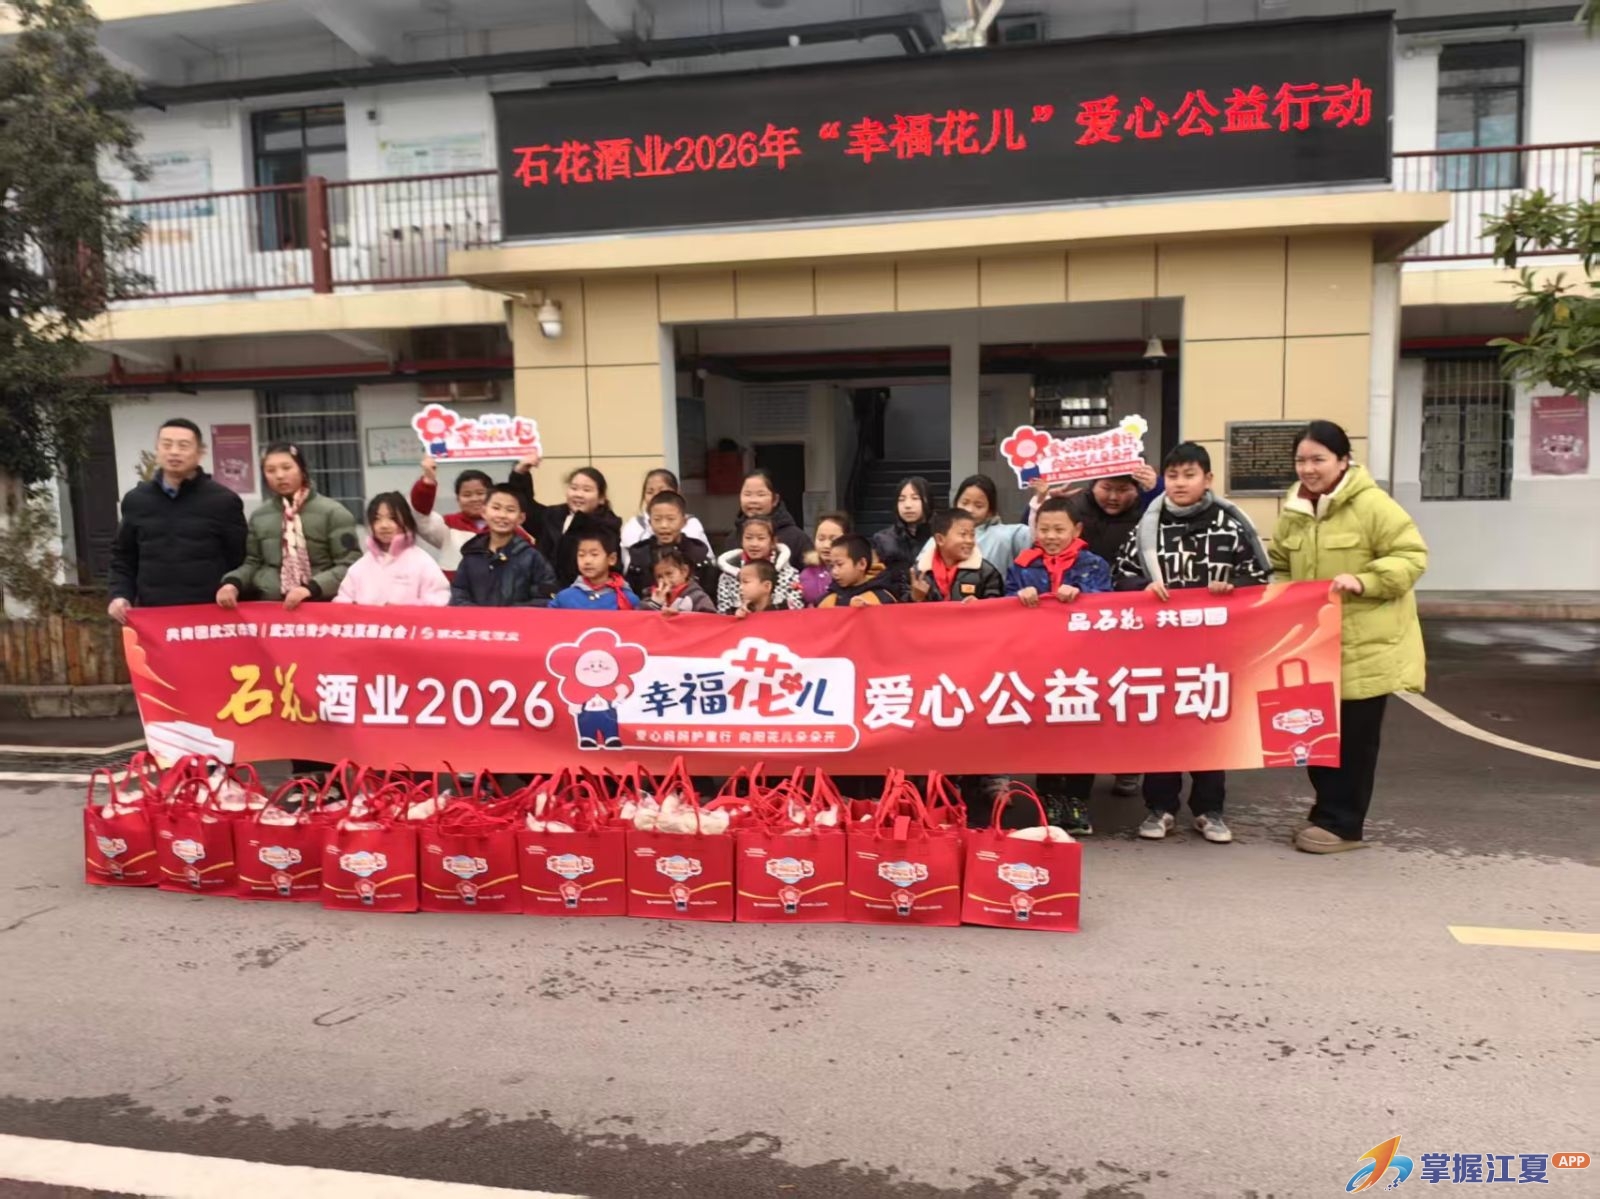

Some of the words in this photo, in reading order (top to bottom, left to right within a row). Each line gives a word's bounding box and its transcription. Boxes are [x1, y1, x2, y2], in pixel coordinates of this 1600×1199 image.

[641, 647, 835, 717] 幸福花儿
[862, 663, 1229, 730] 爱心公益行动
